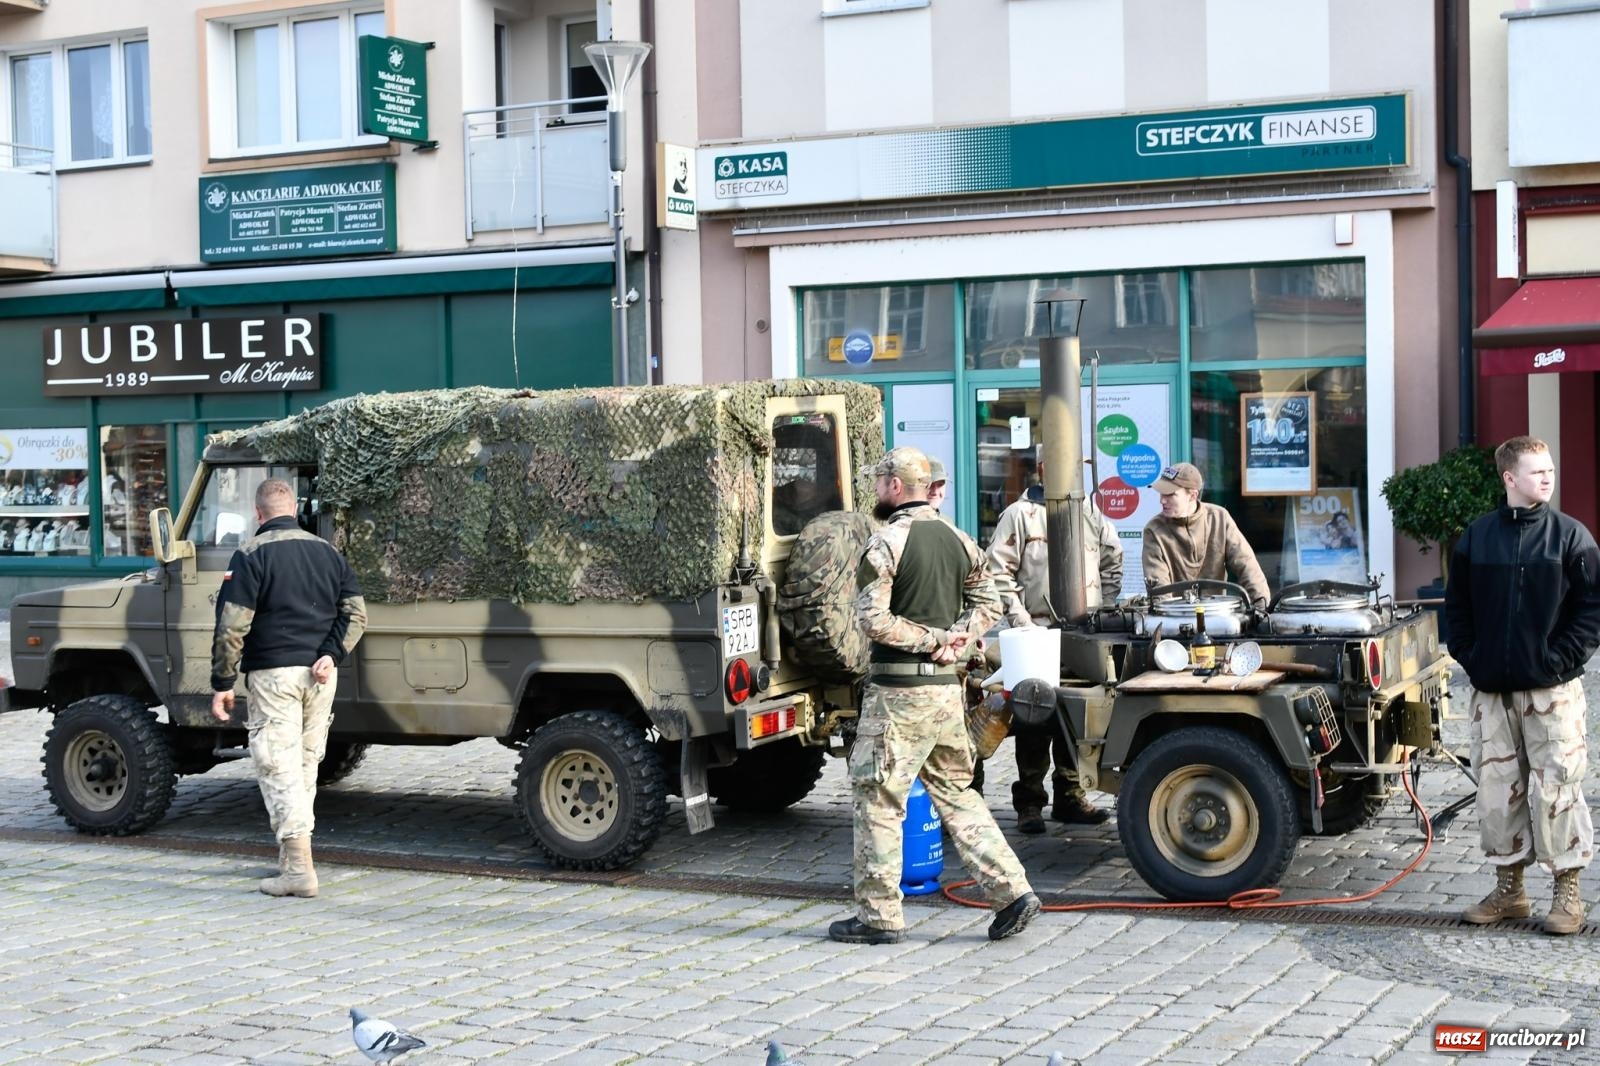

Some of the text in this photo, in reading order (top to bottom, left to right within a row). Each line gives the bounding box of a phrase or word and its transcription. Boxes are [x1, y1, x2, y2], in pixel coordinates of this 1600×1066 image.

[396, 75, 416, 86] Zientek
[384, 82, 410, 93] ADWOKAT
[379, 92, 416, 106] Stefan Zientek
[385, 103, 410, 114] ADWOKAT
[387, 124, 412, 135] ADWOKAT
[1146, 115, 1364, 148] STEFCZYK FINANSE
[1302, 144, 1374, 157] PARTNER
[738, 157, 784, 174] KASA
[231, 180, 382, 203] KANCELARIE ADWOKACKIE
[719, 180, 785, 195] STEFCZYKA
[280, 206, 334, 217] Patrycja Mazurek
[338, 202, 382, 212] Stefan Zientek
[675, 202, 694, 212] KASY
[254, 209, 276, 218] Zientek
[344, 213, 376, 222] ADWOKAT
[239, 220, 270, 229] ADWOKAT
[291, 217, 324, 226] ADWOKAT
[46, 318, 315, 366] JUBILER
[105, 372, 148, 388] 1989
[220, 361, 315, 388] M. Karpisz
[1250, 406, 1272, 415] Tylko
[1104, 426, 1129, 435] Szybka
[17, 436, 74, 449] Obrączki do
[50, 444, 88, 462] -30%
[1122, 454, 1155, 464] Wygodna
[1300, 496, 1341, 515] 500
[731, 608, 752, 629] SRB
